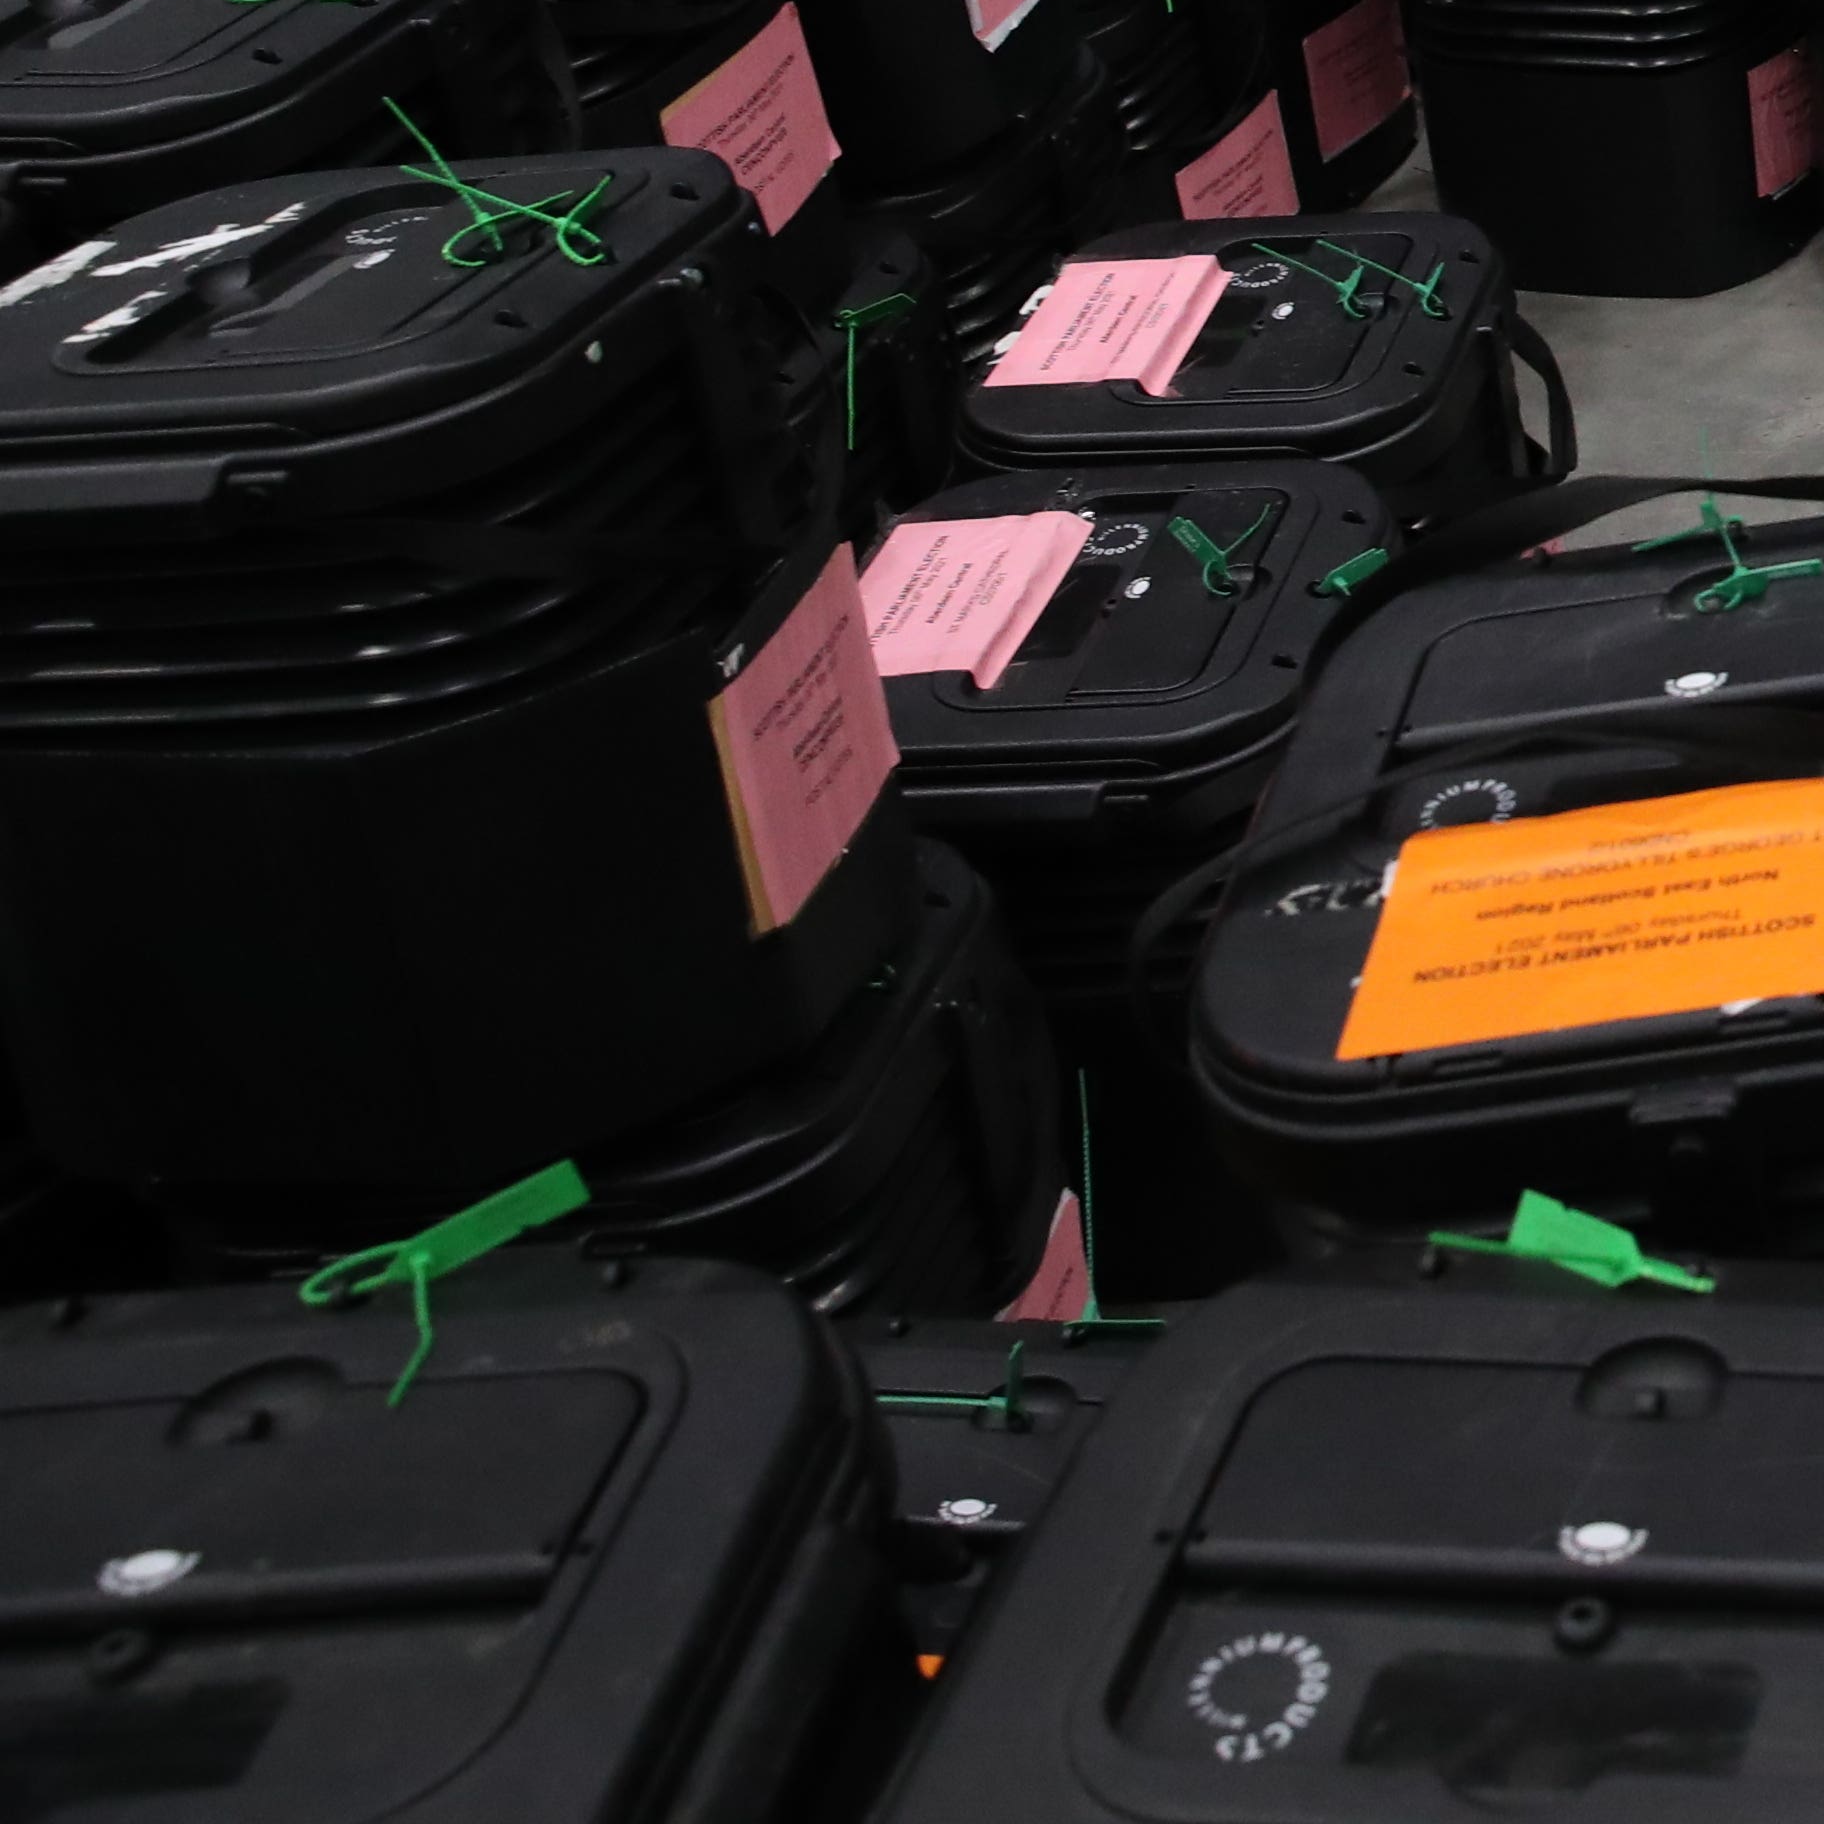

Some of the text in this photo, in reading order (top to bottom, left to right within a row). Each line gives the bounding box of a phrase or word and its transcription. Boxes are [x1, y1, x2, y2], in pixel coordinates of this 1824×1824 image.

[881, 534, 950, 620] PARLIAMENT ELECTION
[922, 561, 973, 624] Aberdeen Central
[1475, 867, 1780, 922] North East Scotland Region
[1412, 913, 1817, 984] SCOTTISH PARLIAMENT ELECTION
